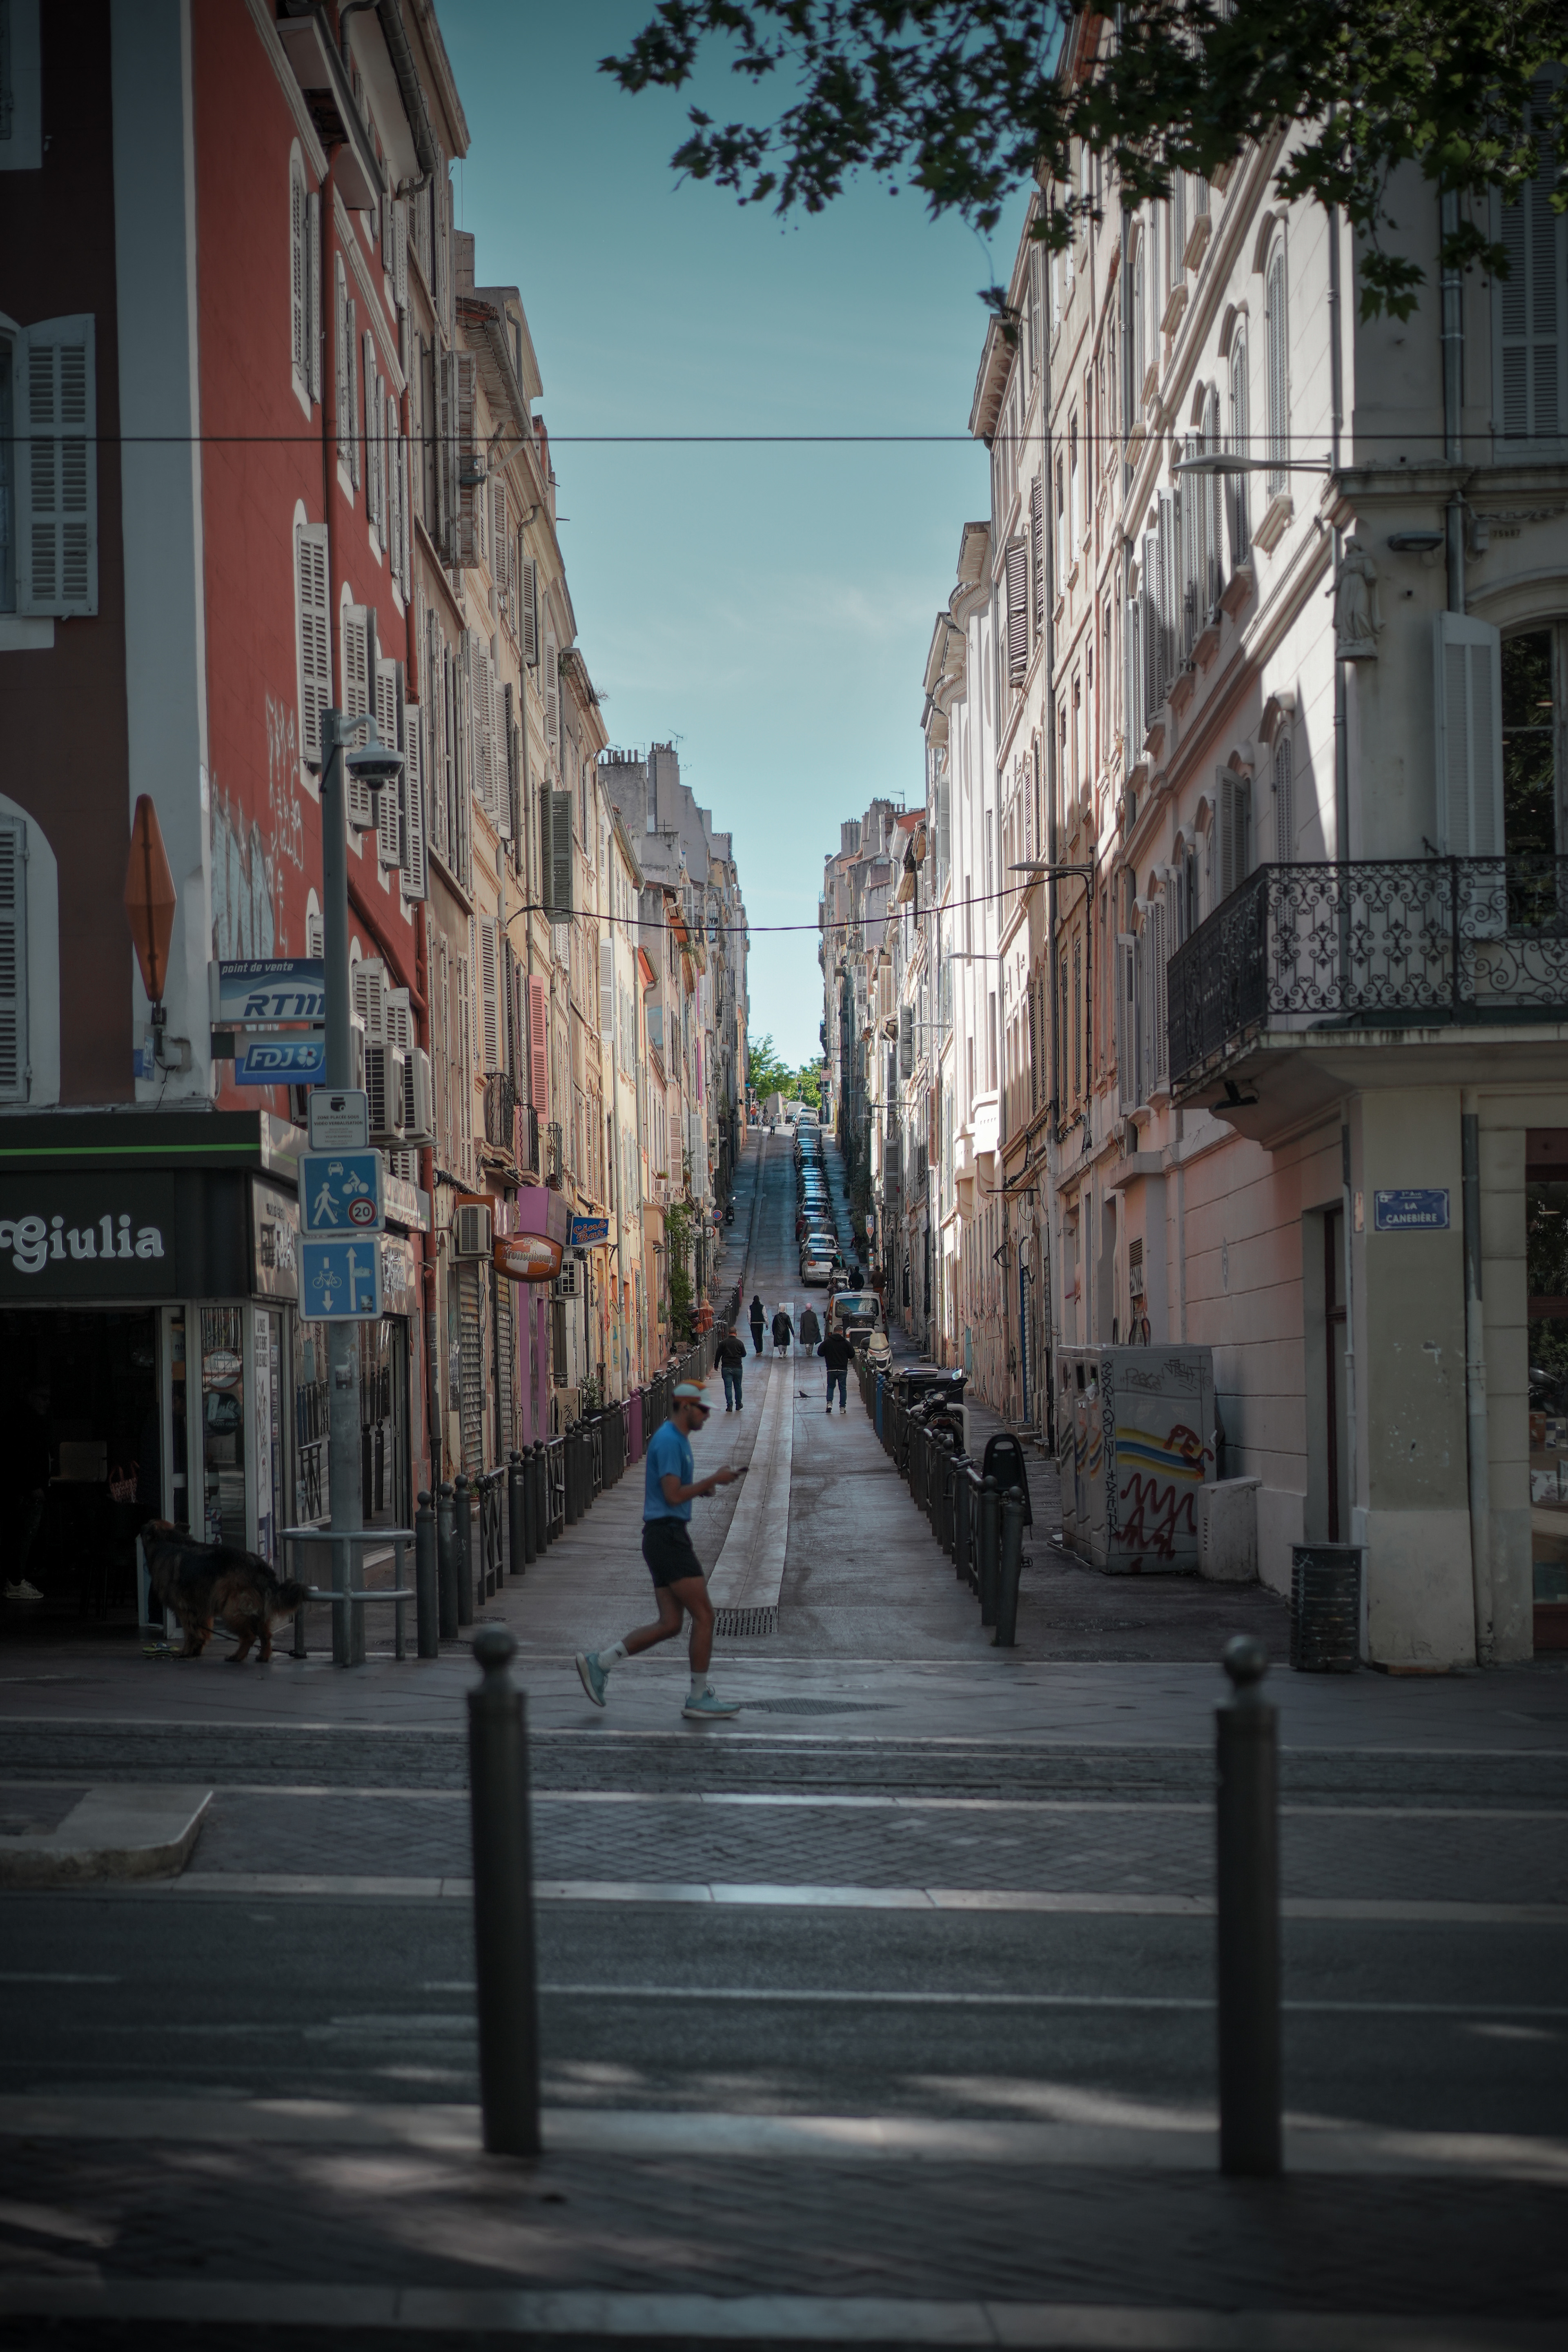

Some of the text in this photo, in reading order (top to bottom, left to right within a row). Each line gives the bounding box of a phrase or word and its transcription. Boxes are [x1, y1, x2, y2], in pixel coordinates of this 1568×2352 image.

[222, 961, 294, 975] point de vente
[250, 1047, 295, 1067] FDJ
[354, 1207, 370, 1217] 20
[1386, 1211, 1437, 1223] CANEBIÈRE
[573, 1220, 607, 1235] Ciné
[0, 1214, 165, 1273] Giulia
[577, 1230, 606, 1243] Bar
[500, 1245, 557, 1268] Kronenbourg
